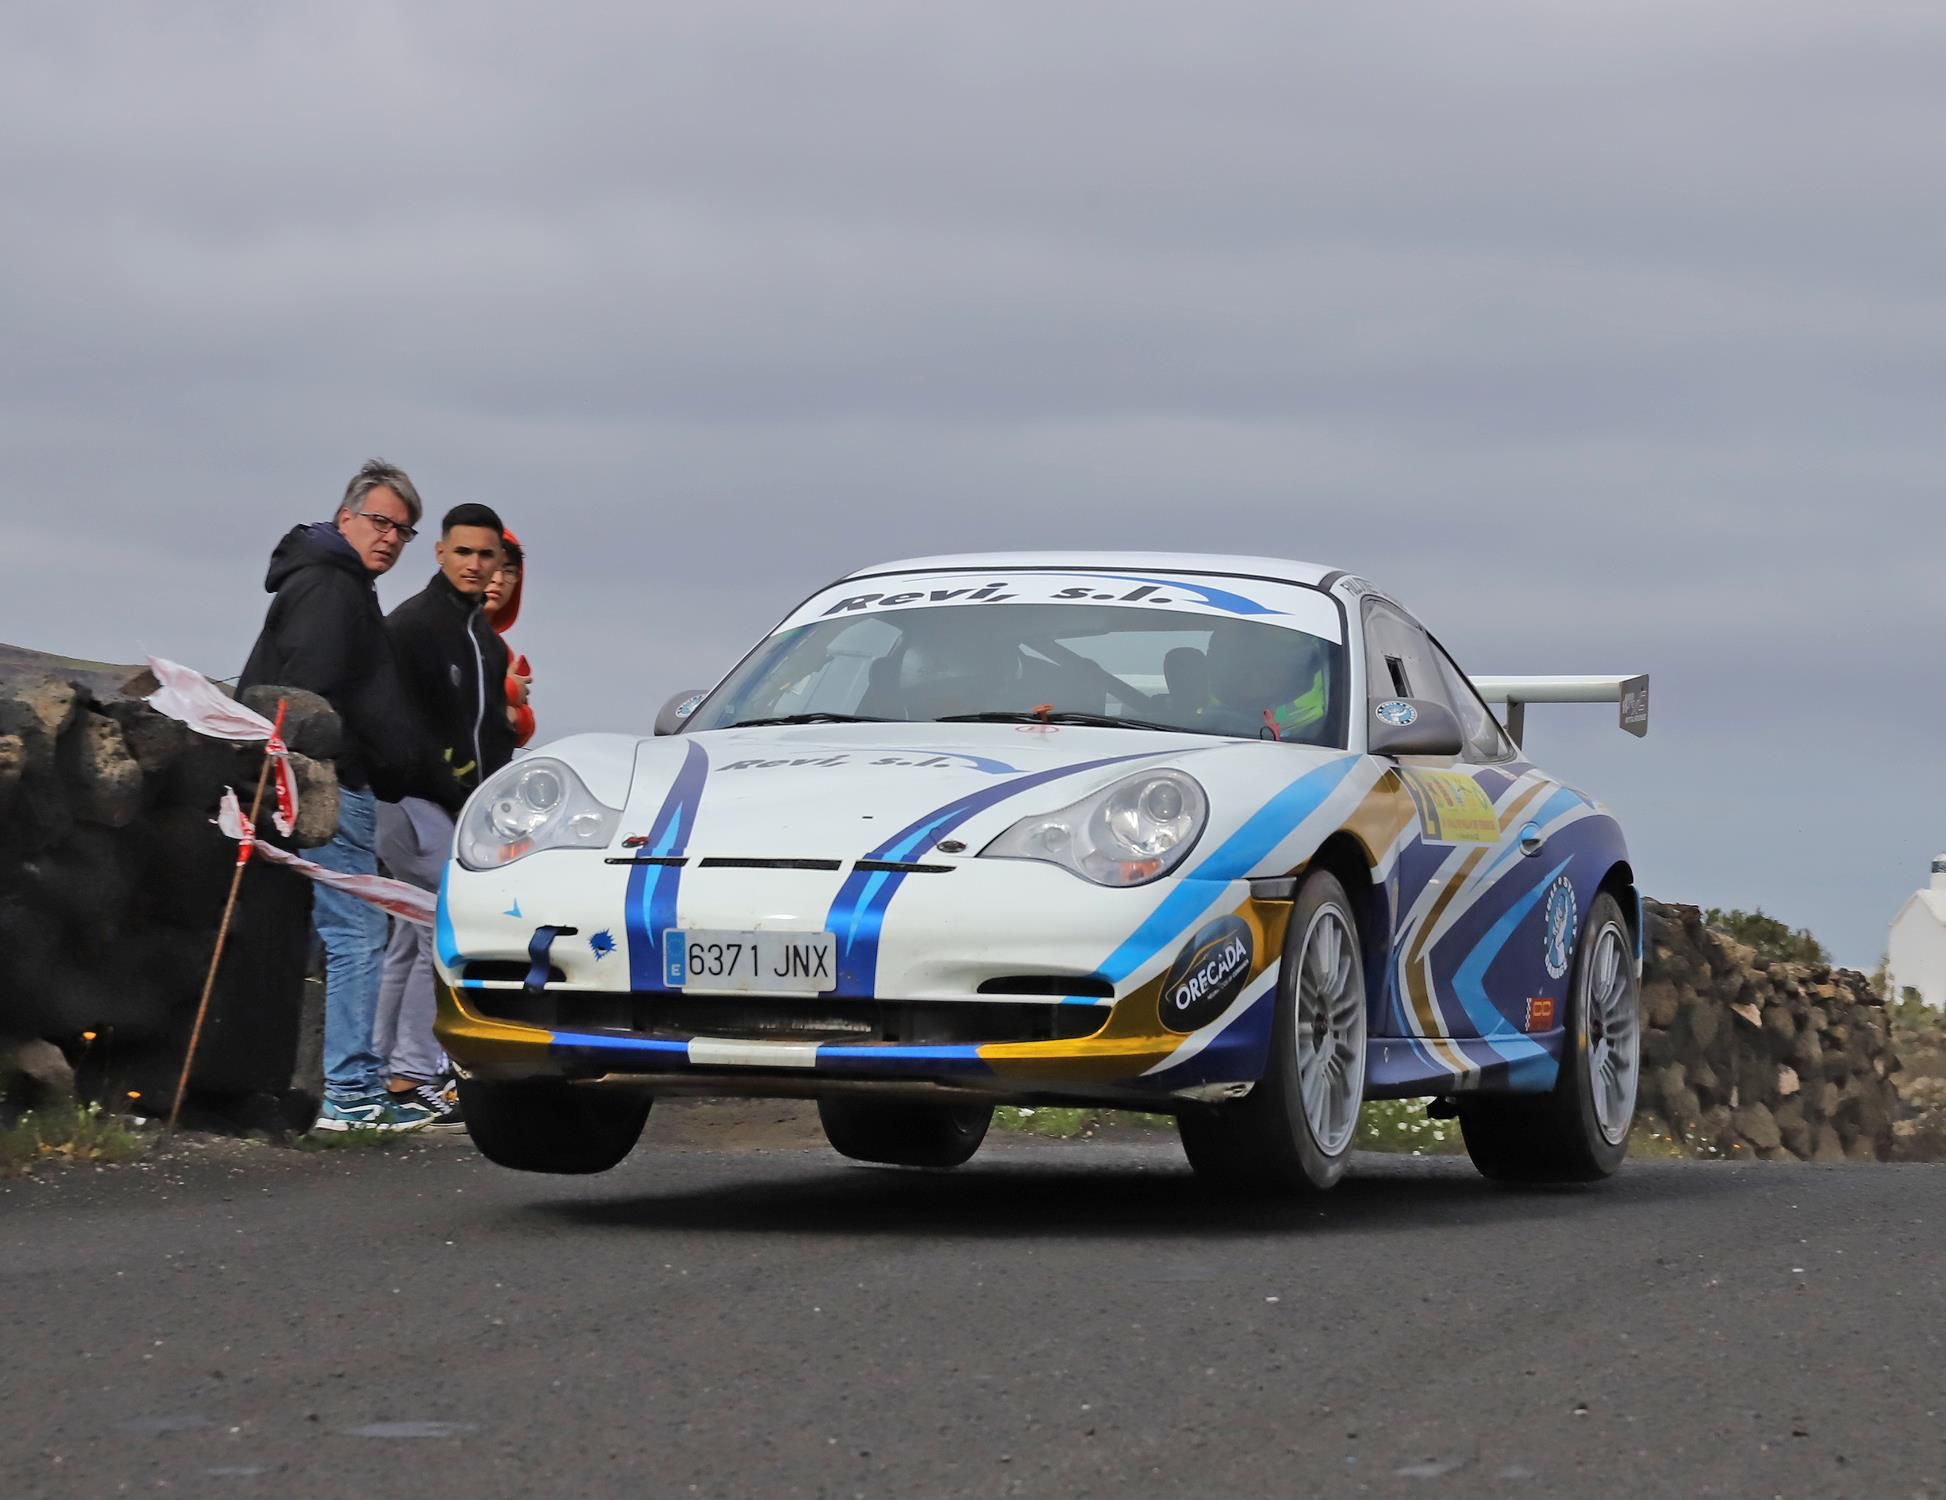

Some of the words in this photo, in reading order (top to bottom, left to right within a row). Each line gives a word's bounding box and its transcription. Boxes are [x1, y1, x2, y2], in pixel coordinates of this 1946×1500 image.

[1049, 586, 1173, 604] s.l.
[689, 943, 759, 977] 6371
[774, 944, 828, 977] JNX
[671, 963, 681, 976] E
